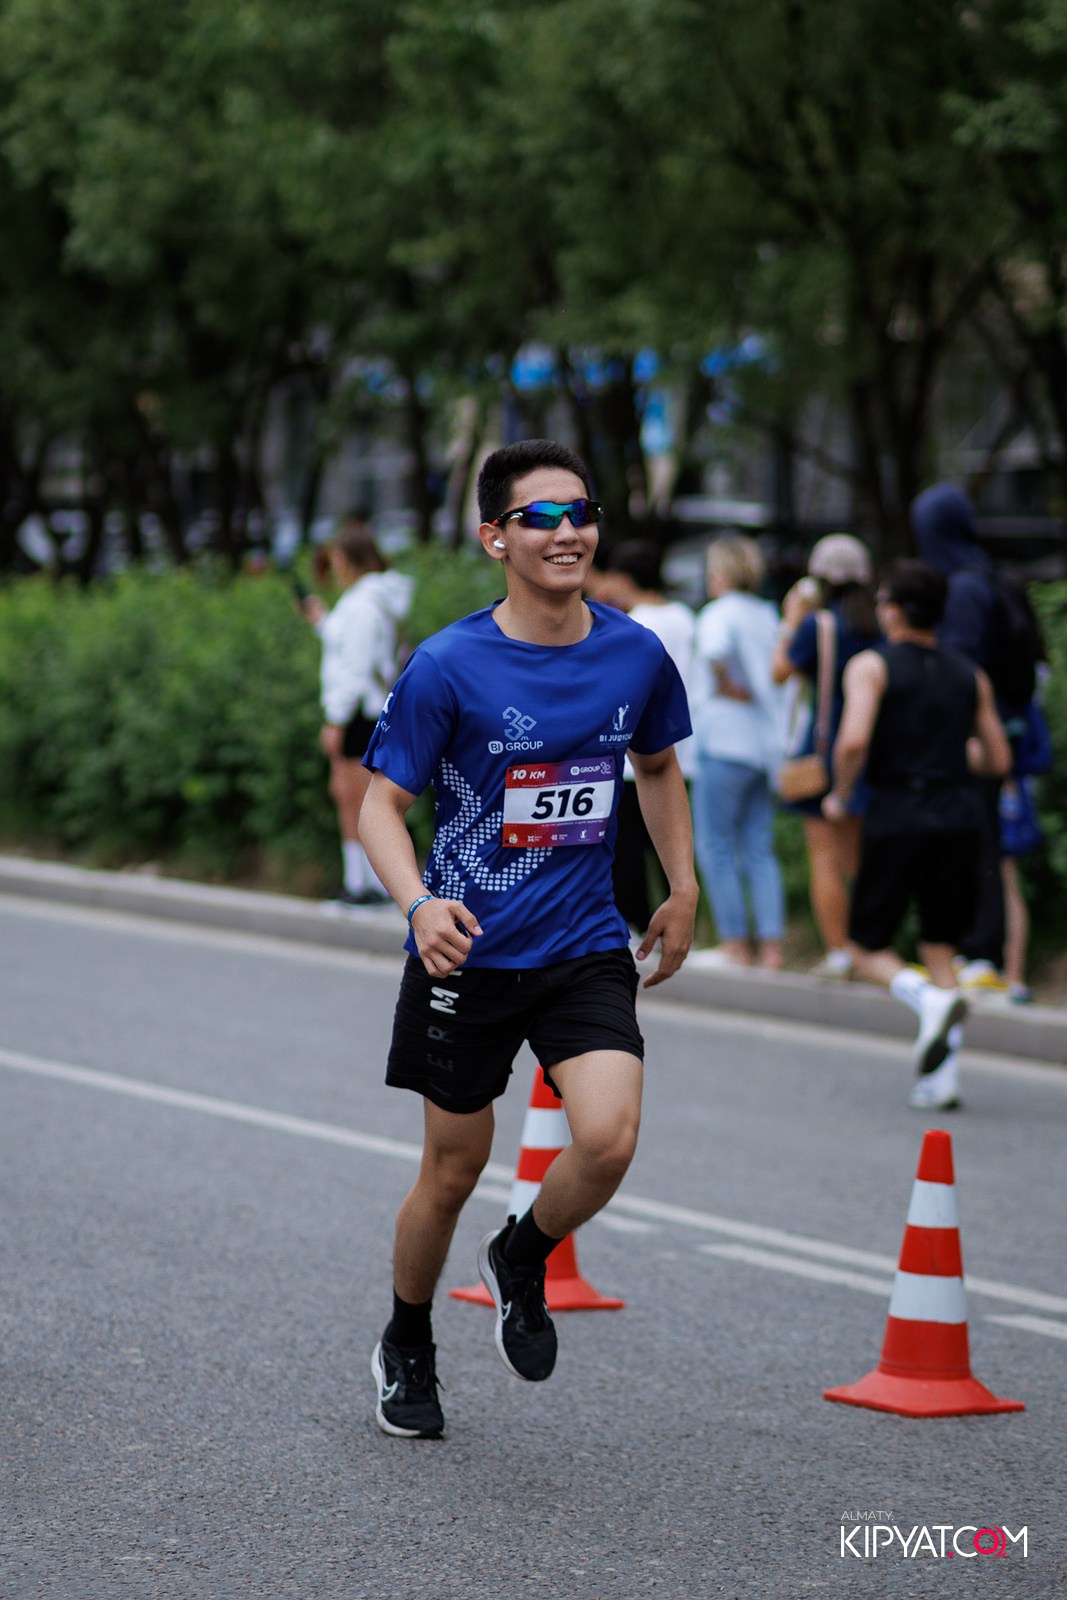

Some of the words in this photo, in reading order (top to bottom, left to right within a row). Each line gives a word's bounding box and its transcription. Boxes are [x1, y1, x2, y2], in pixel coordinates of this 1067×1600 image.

[599, 734, 607, 742] BI
[489, 741, 502, 753] BI
[505, 741, 544, 751] GROUP
[512, 769, 526, 780] 10
[529, 770, 546, 780] KM
[580, 765, 601, 774] GROUP
[530, 786, 595, 820] 516
